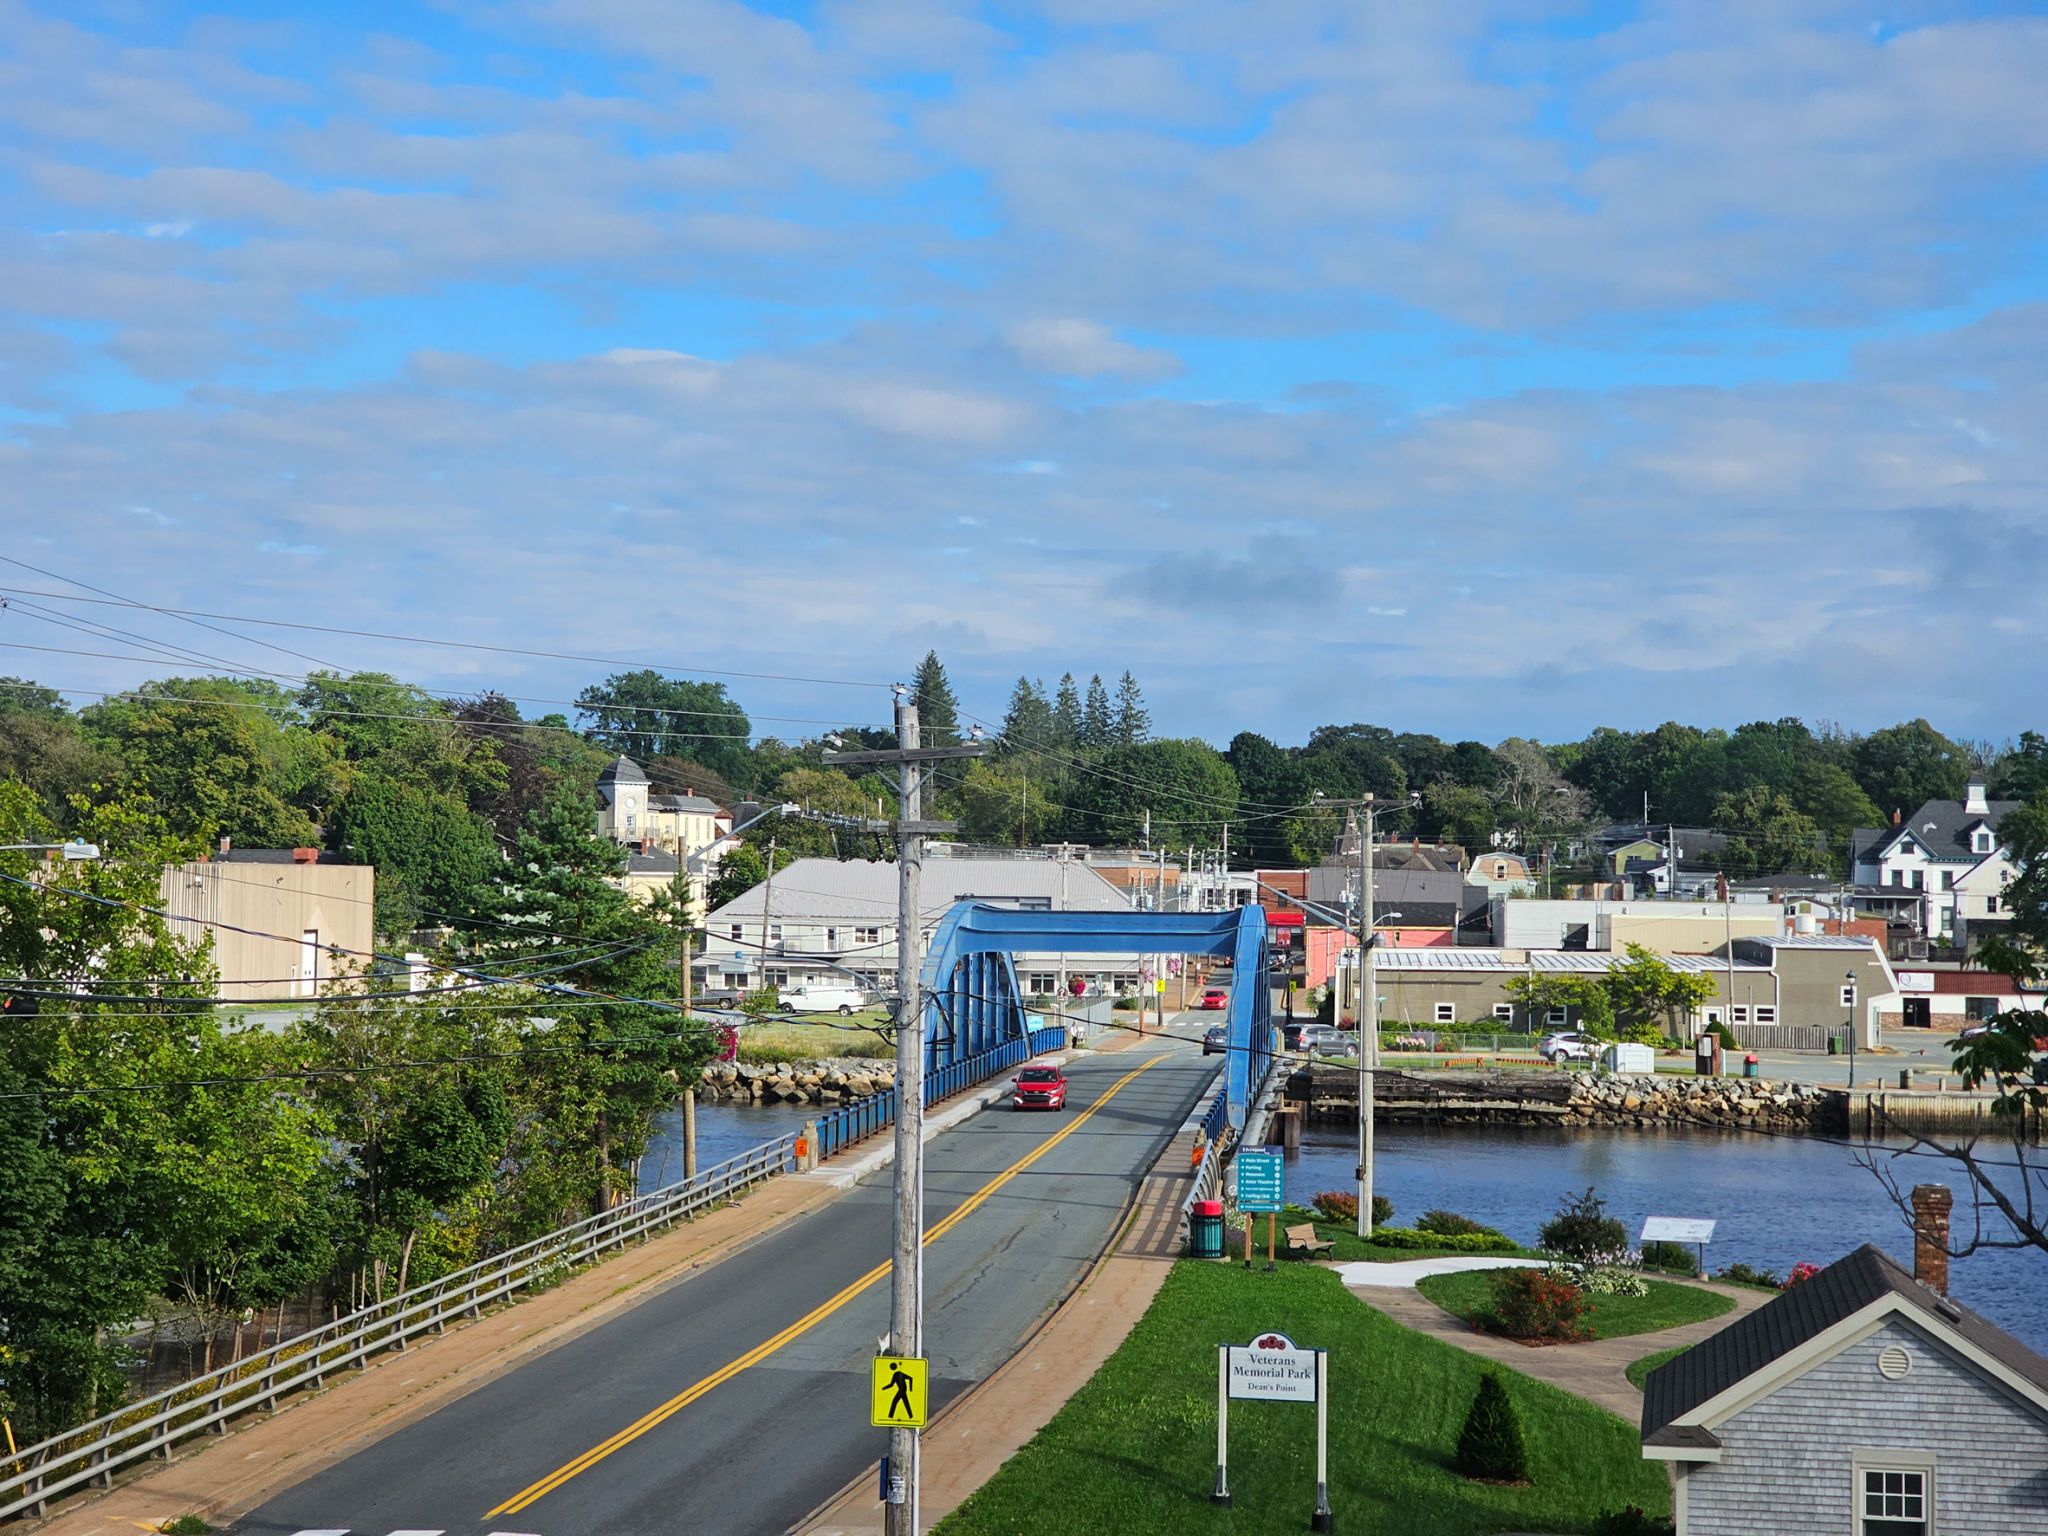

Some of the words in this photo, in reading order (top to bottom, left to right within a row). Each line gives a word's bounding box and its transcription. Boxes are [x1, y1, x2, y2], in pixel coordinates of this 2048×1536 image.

[1249, 1353, 1296, 1366] Veterans
[1233, 1366, 1284, 1378] Memorial
[1288, 1369, 1312, 1380] Park
[1248, 1382, 1274, 1392] Dean's
[1276, 1384, 1297, 1393] Point
